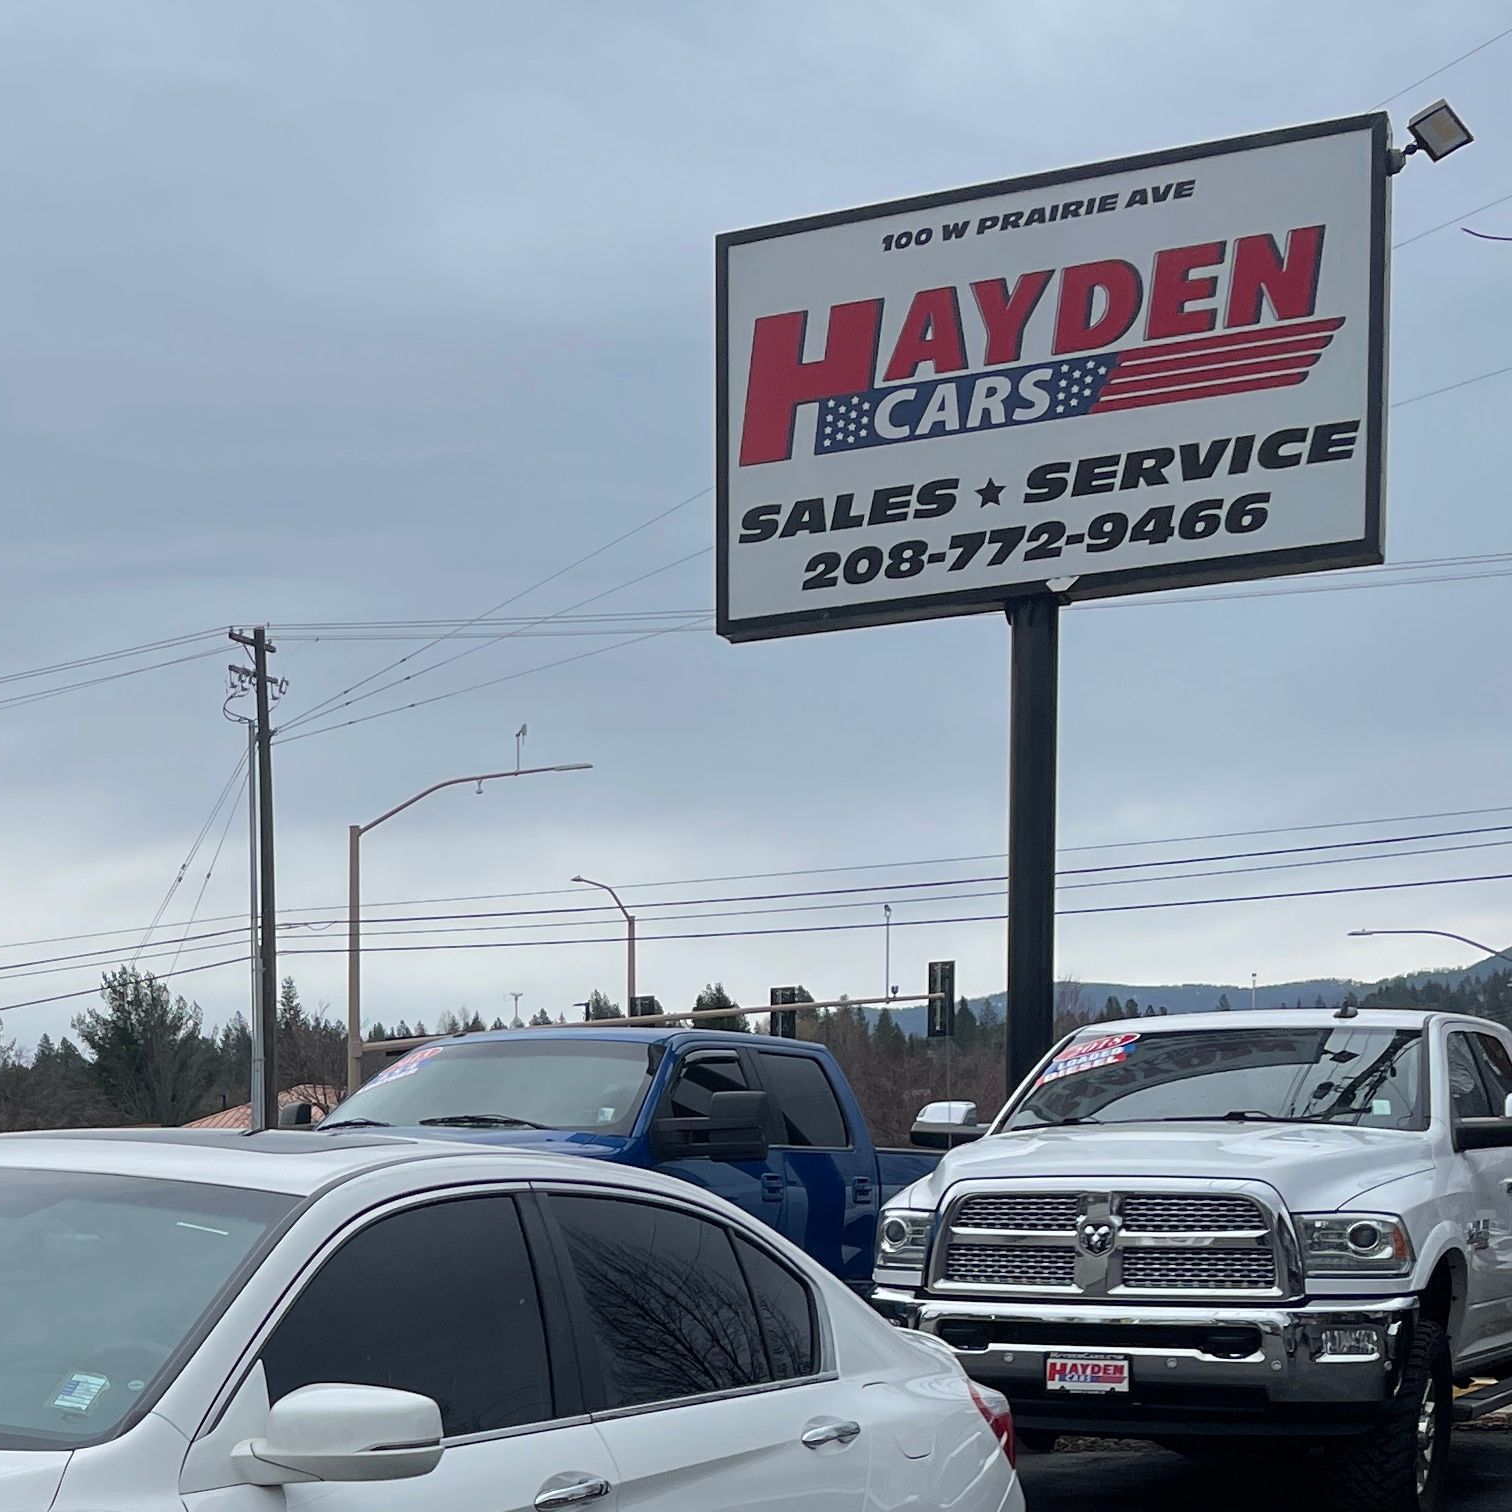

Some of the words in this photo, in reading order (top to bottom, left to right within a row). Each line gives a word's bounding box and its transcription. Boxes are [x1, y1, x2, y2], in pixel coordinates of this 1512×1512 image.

[881, 226, 933, 252] 100
[940, 220, 973, 241] W
[976, 195, 1120, 236] PRAIRIE
[1123, 179, 1197, 207] AVE
[739, 224, 1327, 467] HAYDEN
[872, 366, 1056, 441] CARS
[738, 477, 961, 545] SALES
[1023, 419, 1362, 504] SERVICE
[801, 492, 1272, 590] 208-772-9466
[1043, 1056, 1120, 1083] DIESEL
[1058, 1046, 1126, 1071] LOADED
[1048, 1362, 1125, 1381] HAYDEN
